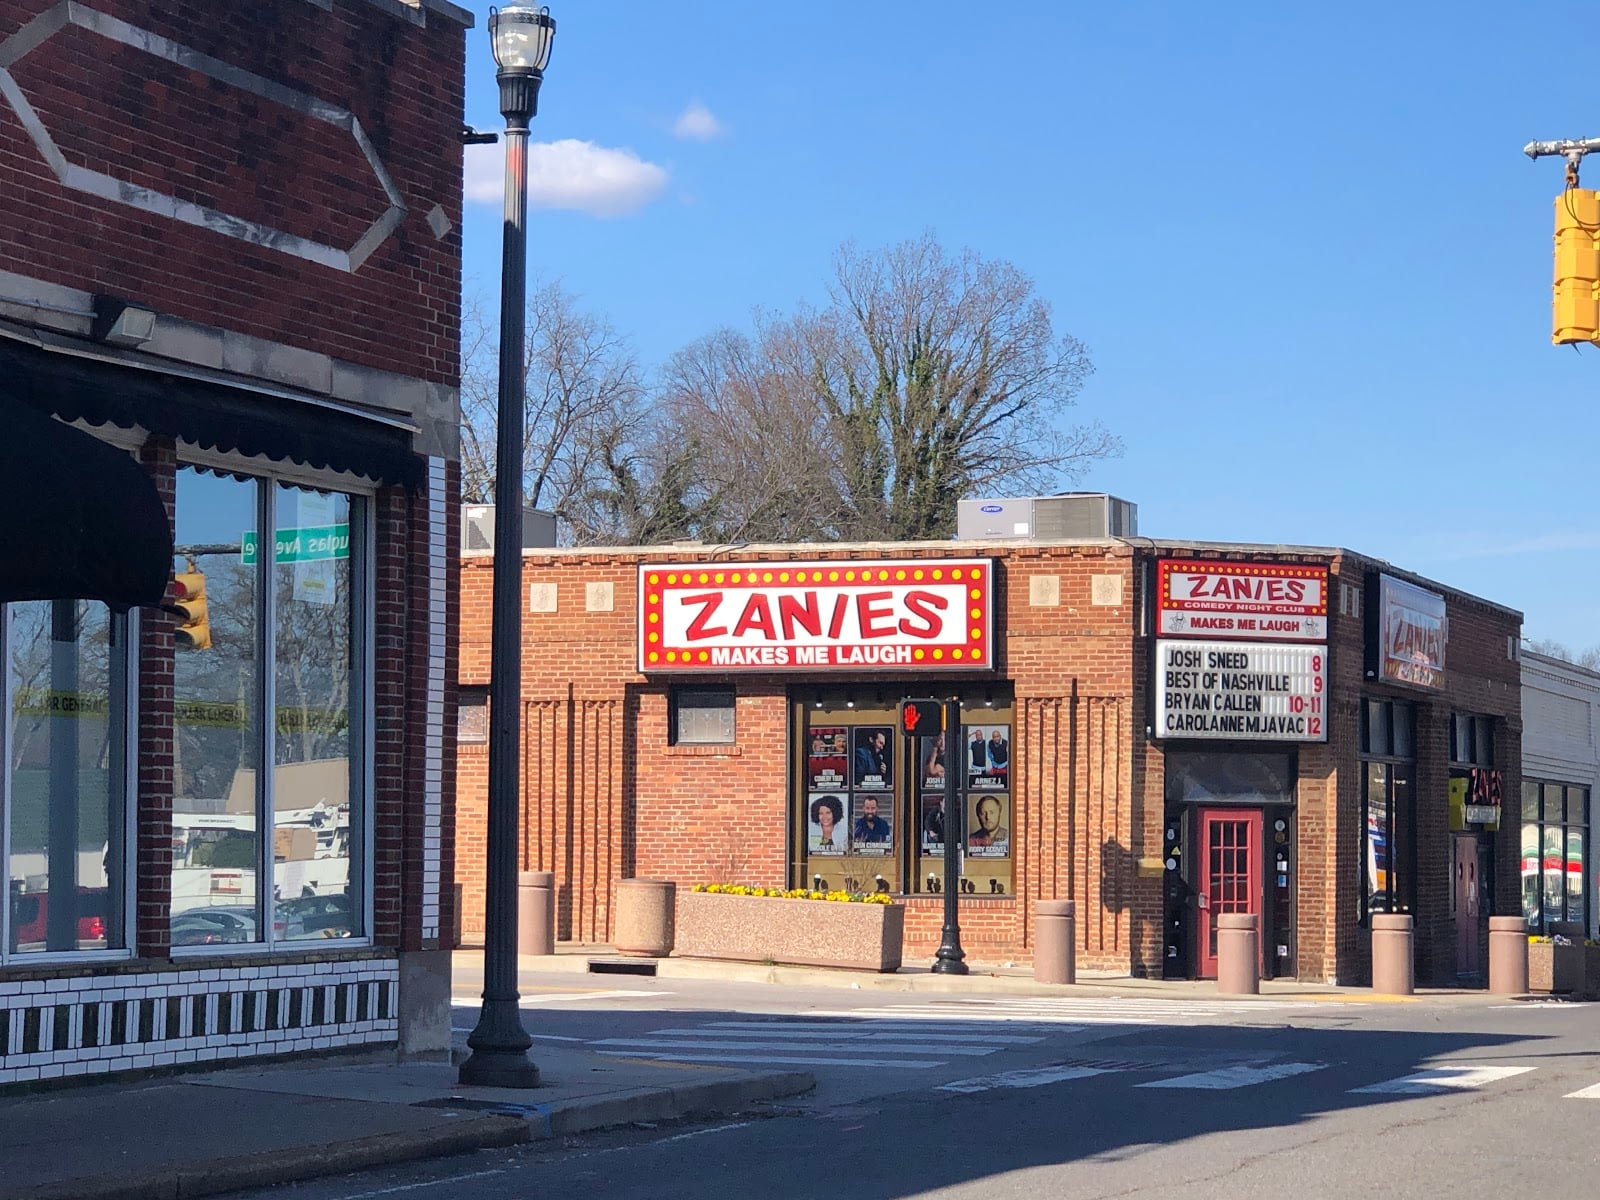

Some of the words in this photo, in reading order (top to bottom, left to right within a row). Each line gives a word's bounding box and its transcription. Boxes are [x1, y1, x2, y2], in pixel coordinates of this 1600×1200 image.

[1187, 575, 1306, 602] ZANIES
[681, 591, 948, 641] ZANIES
[1184, 601, 1233, 610] COMEDY
[1236, 603, 1272, 612] NIGHT
[1275, 604, 1305, 613] CLUB
[1190, 617, 1234, 630] MAKES
[1237, 618, 1256, 630] ME
[1259, 619, 1300, 632] LAUGH
[711, 647, 789, 665] MAKES
[796, 646, 829, 664] ME
[837, 646, 911, 664] LAUGH
[1167, 650, 1200, 668] JOSH
[1208, 652, 1249, 669] SNEED
[1312, 655, 1321, 672] 8
[1166, 672, 1199, 689] BEST
[1202, 673, 1218, 689] OF
[1221, 674, 1289, 692] NASHVILLE
[1313, 676, 1323, 693] 9
[1165, 693, 1210, 711] BRYAN
[1213, 694, 1261, 712] CALLEN
[1289, 695, 1321, 713] 10-11
[1308, 717, 1321, 734] 12
